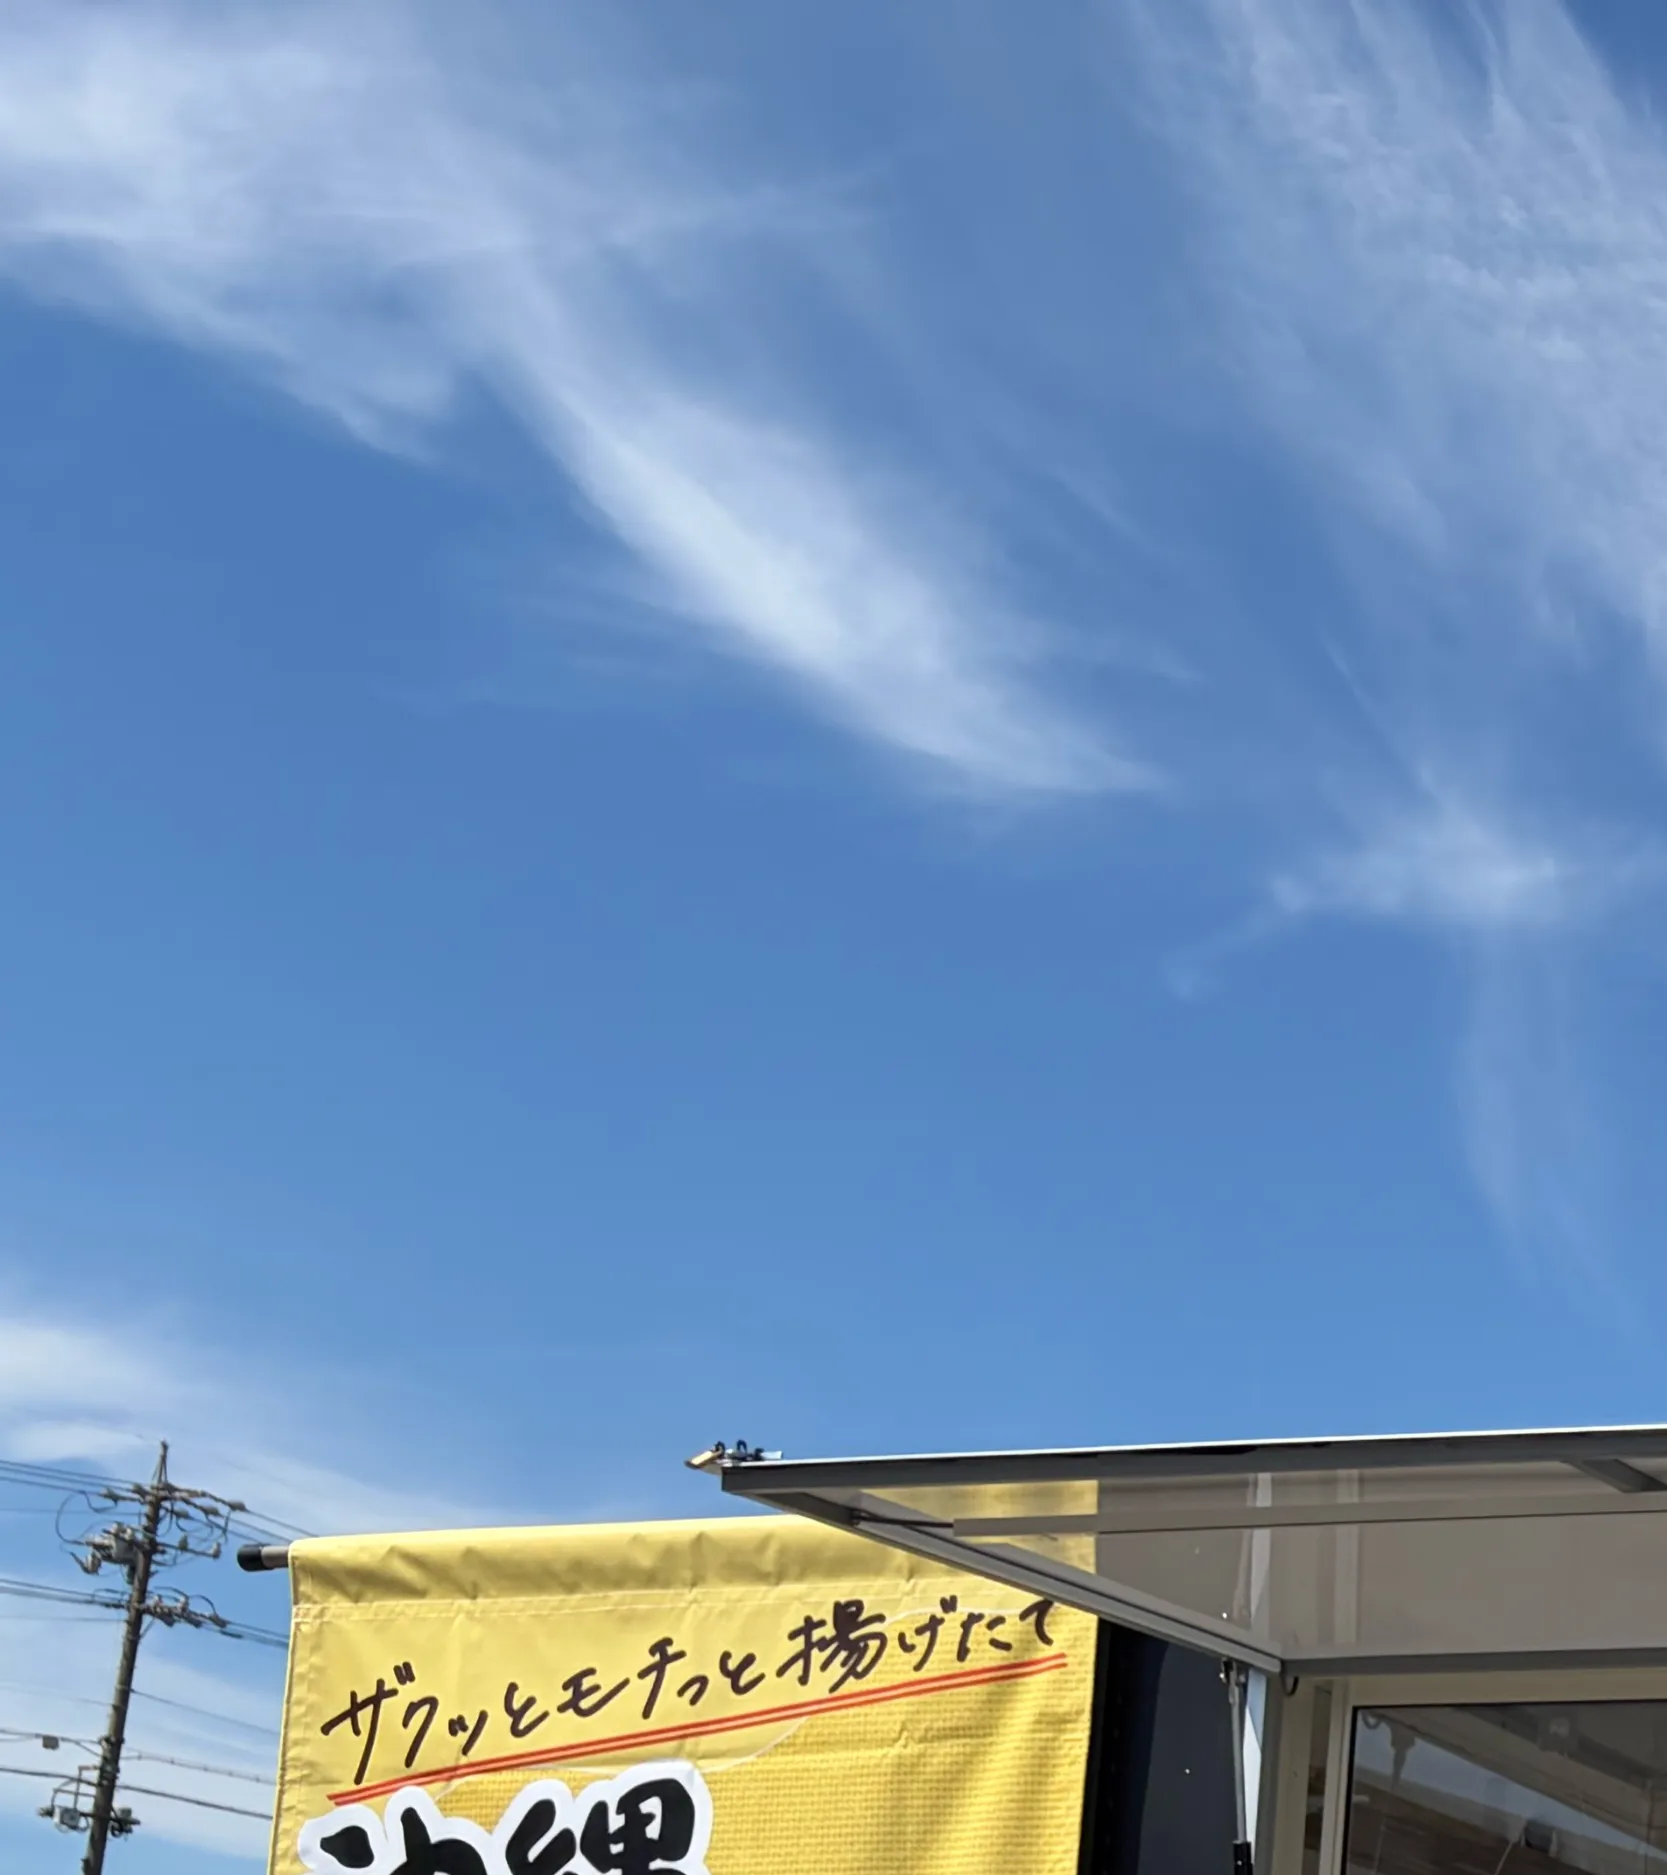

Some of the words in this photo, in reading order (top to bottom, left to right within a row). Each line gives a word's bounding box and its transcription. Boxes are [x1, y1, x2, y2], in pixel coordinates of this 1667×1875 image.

[322, 1596, 1058, 1785] ザクッとモチっと揚げたて
